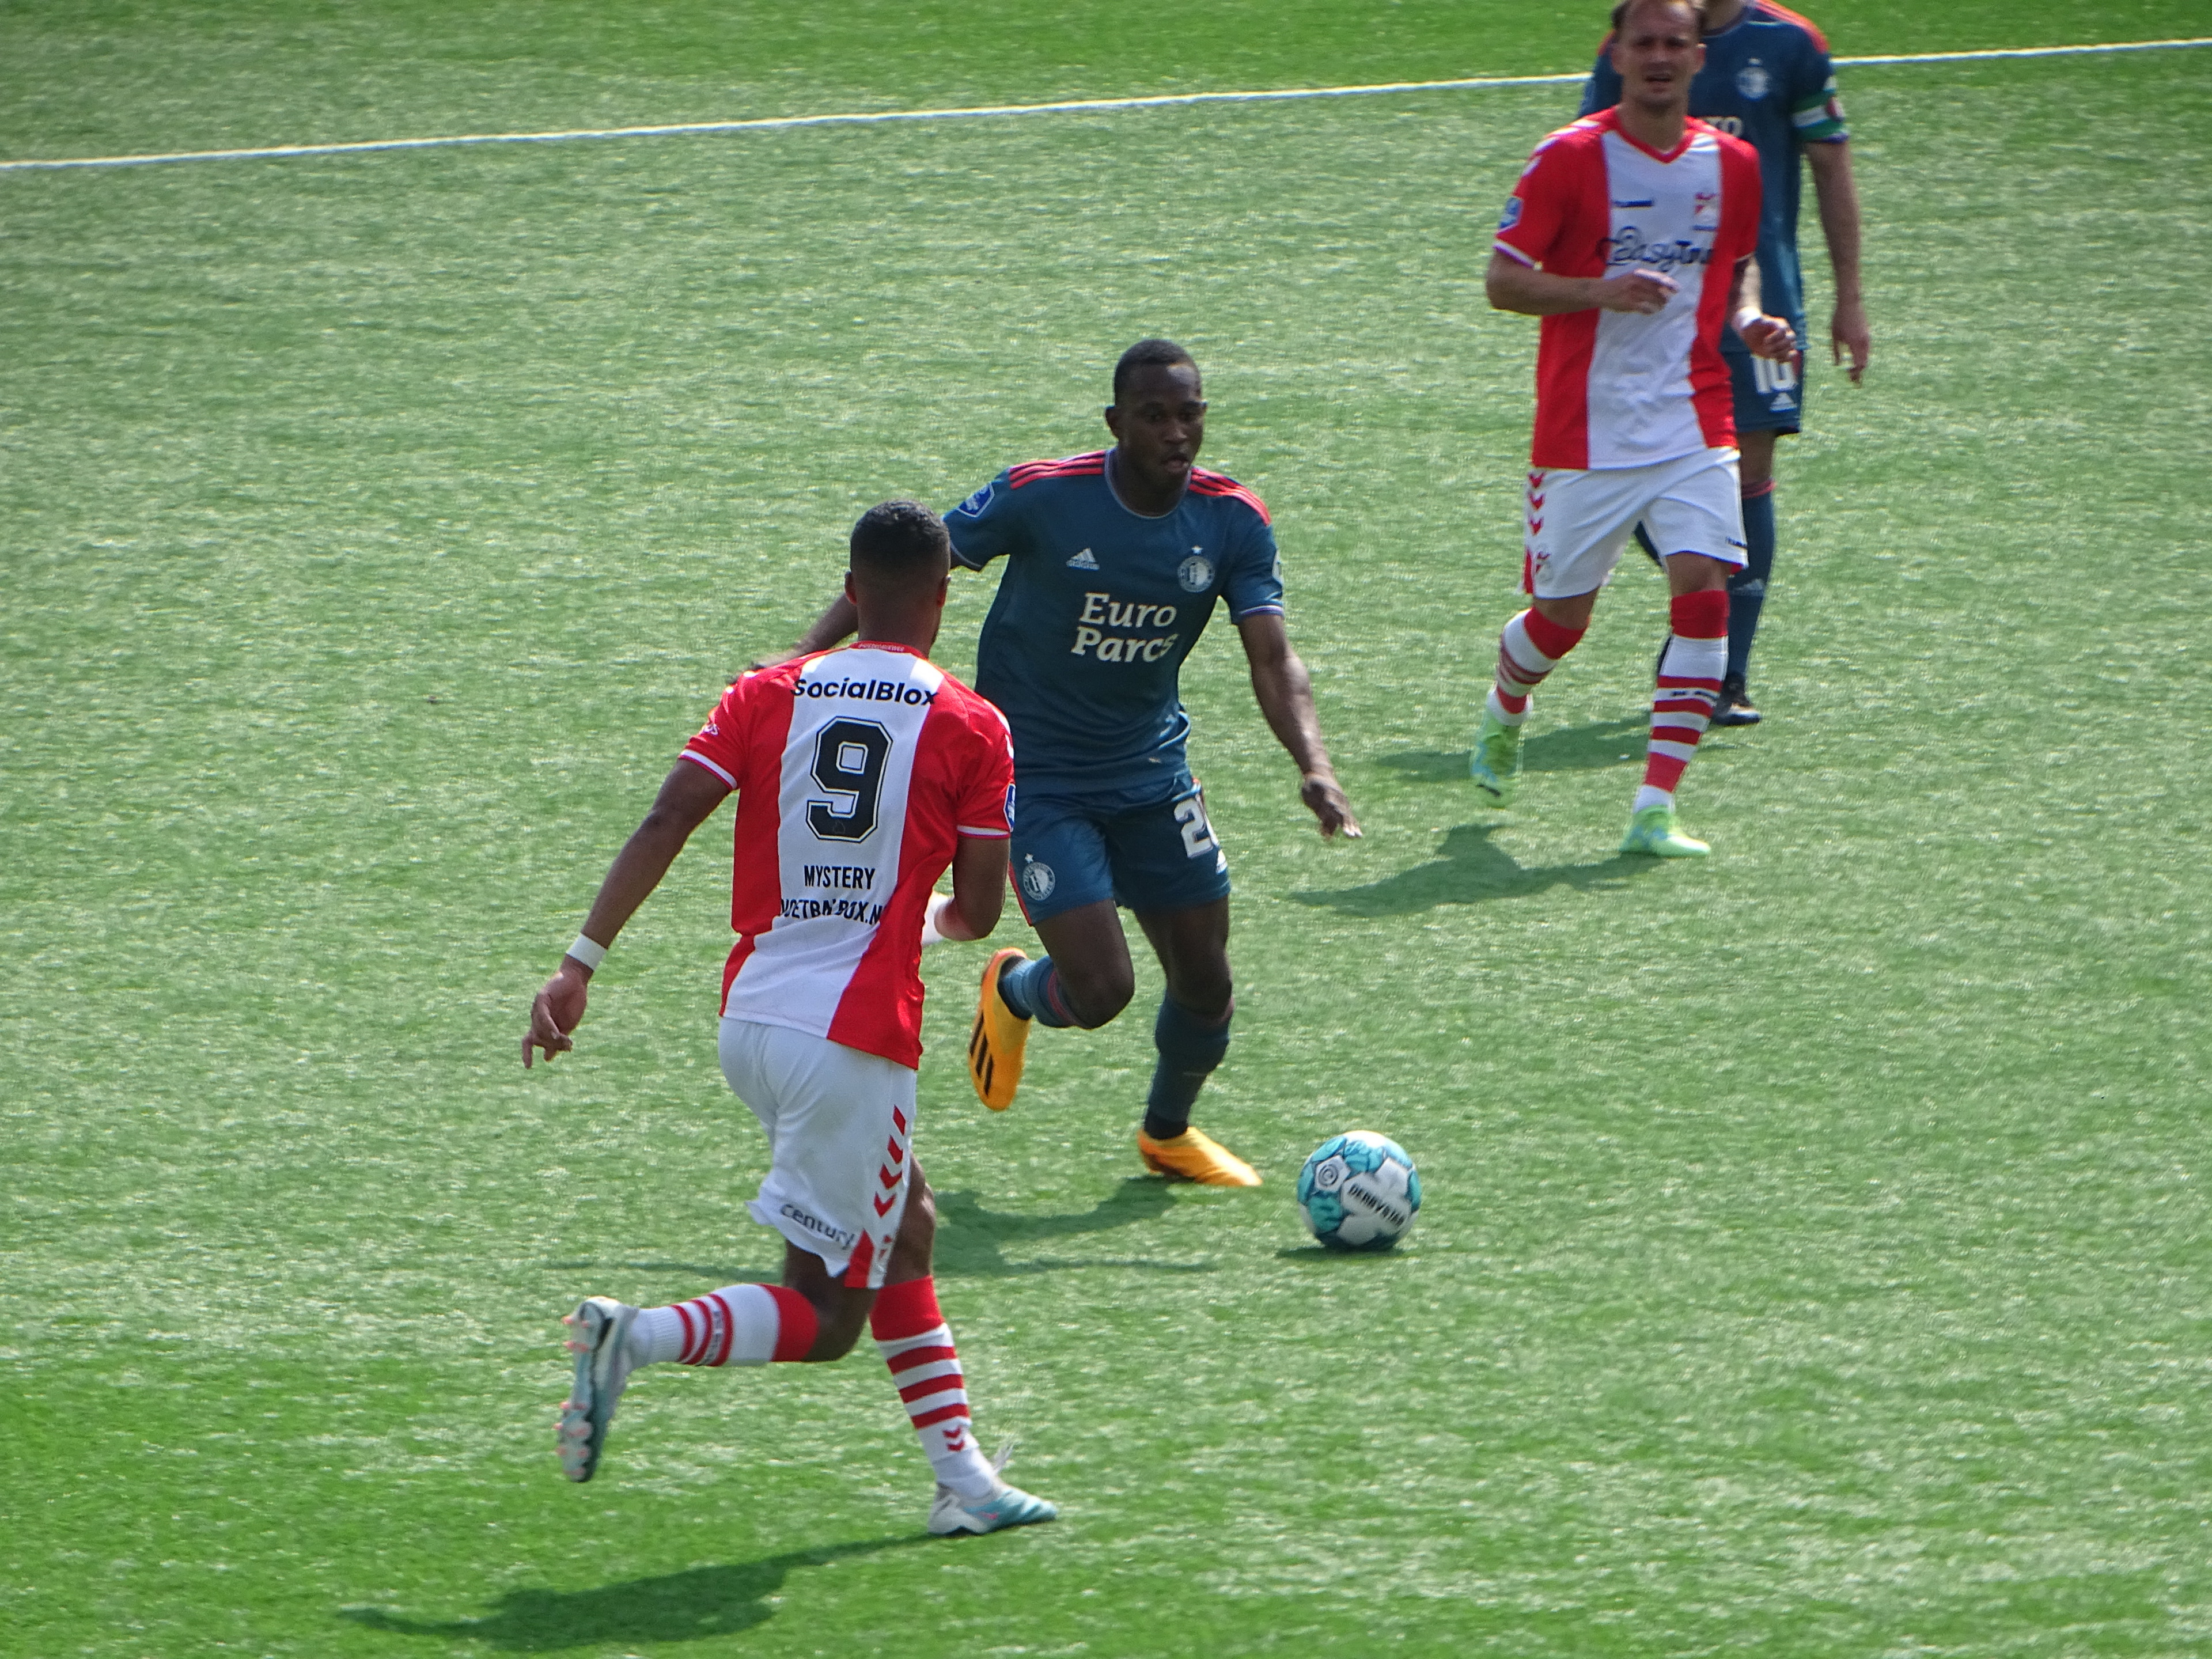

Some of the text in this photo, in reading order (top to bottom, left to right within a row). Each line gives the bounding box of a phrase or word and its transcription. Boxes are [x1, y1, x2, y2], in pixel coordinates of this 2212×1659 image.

[1080, 592, 1177, 628] Euro
[1070, 625, 1180, 663] Parcs
[791, 677, 940, 706] SocialBlox
[806, 715, 894, 843] 9
[1173, 793, 1220, 859] 2
[804, 865, 876, 890] MYSTERY
